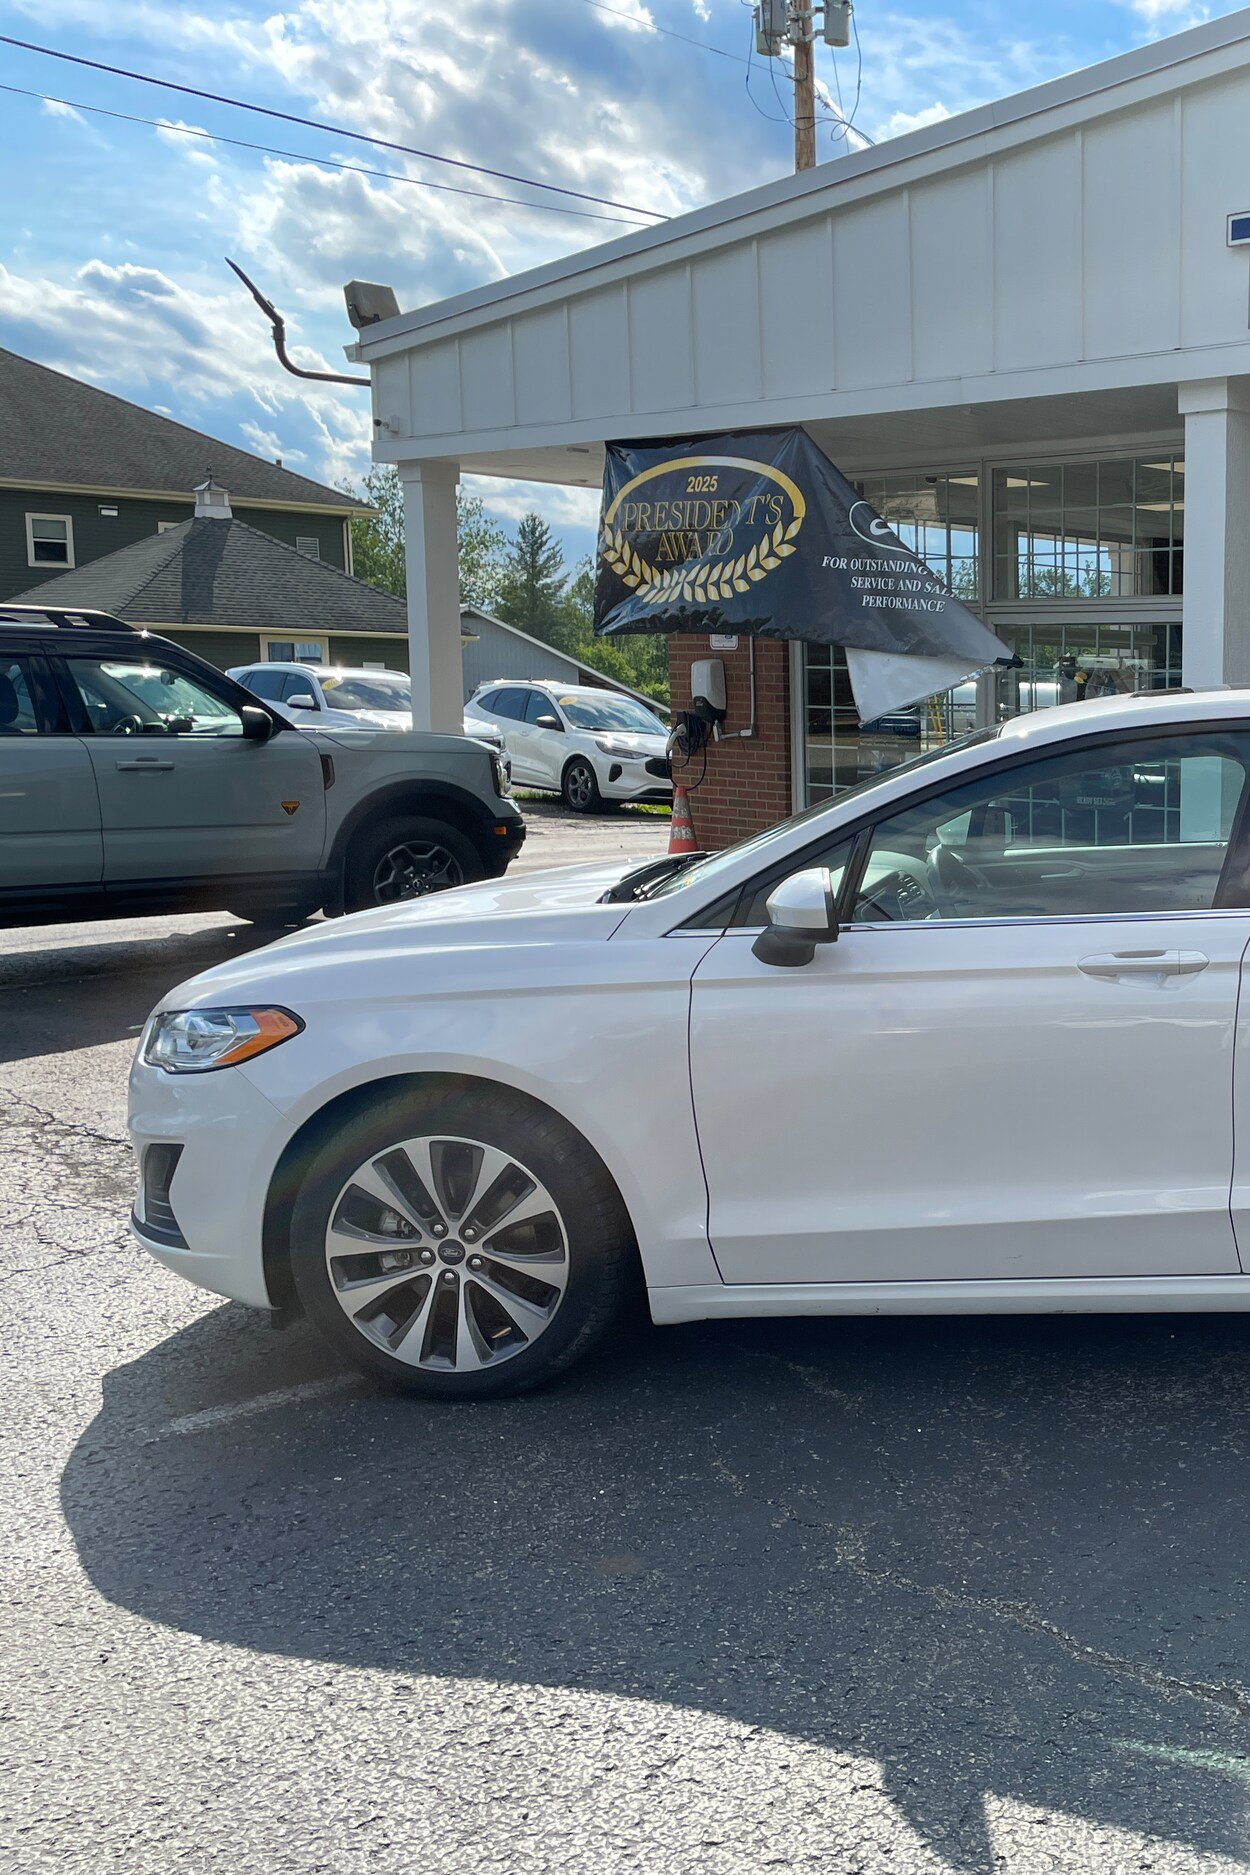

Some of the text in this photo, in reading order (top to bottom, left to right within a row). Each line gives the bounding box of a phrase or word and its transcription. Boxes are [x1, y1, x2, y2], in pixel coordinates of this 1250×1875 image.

[686, 476, 718, 492] 2025
[655, 528, 734, 561] AWARD
[822, 556, 929, 575] FOR OUTSTANDING
[851, 576, 959, 599] SERVICE AND SAL
[862, 595, 945, 612] PERFORMANCE
